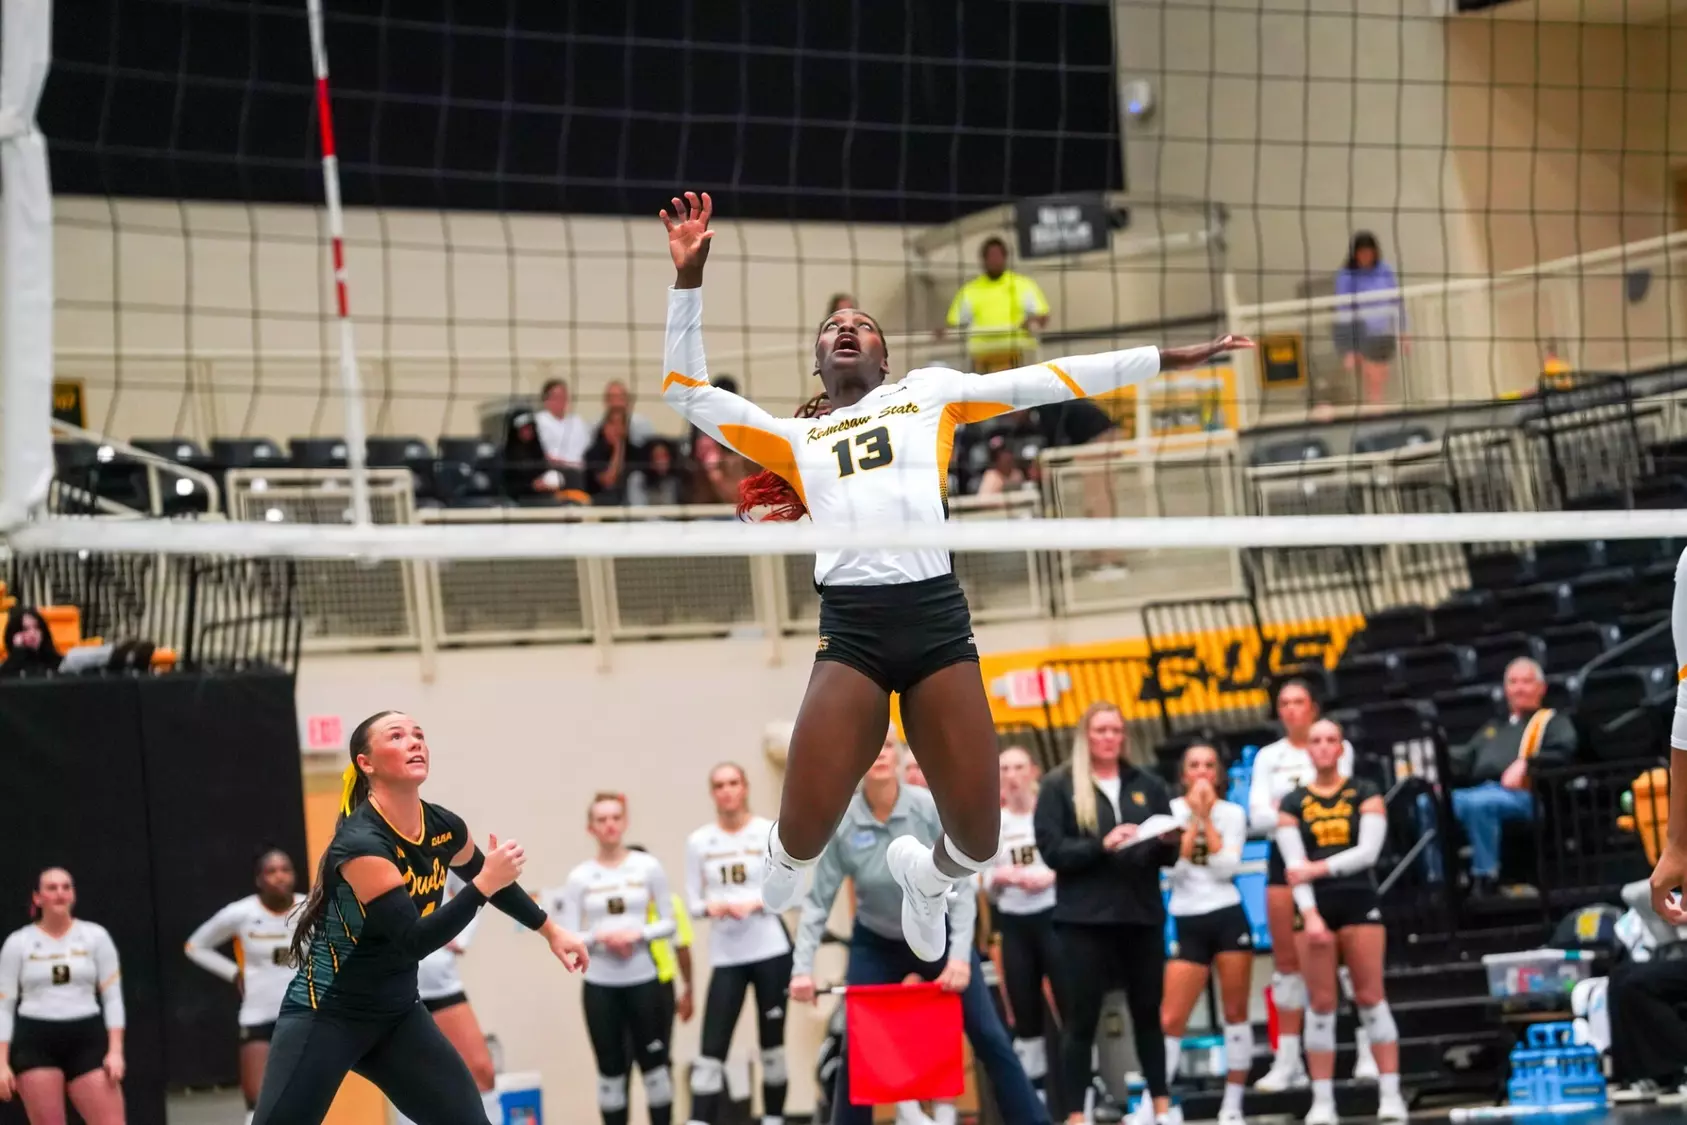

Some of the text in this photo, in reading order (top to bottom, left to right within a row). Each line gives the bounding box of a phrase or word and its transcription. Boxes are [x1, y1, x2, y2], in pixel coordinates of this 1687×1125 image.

[806, 402, 920, 444] Kennesaw State
[831, 426, 894, 478] 13
